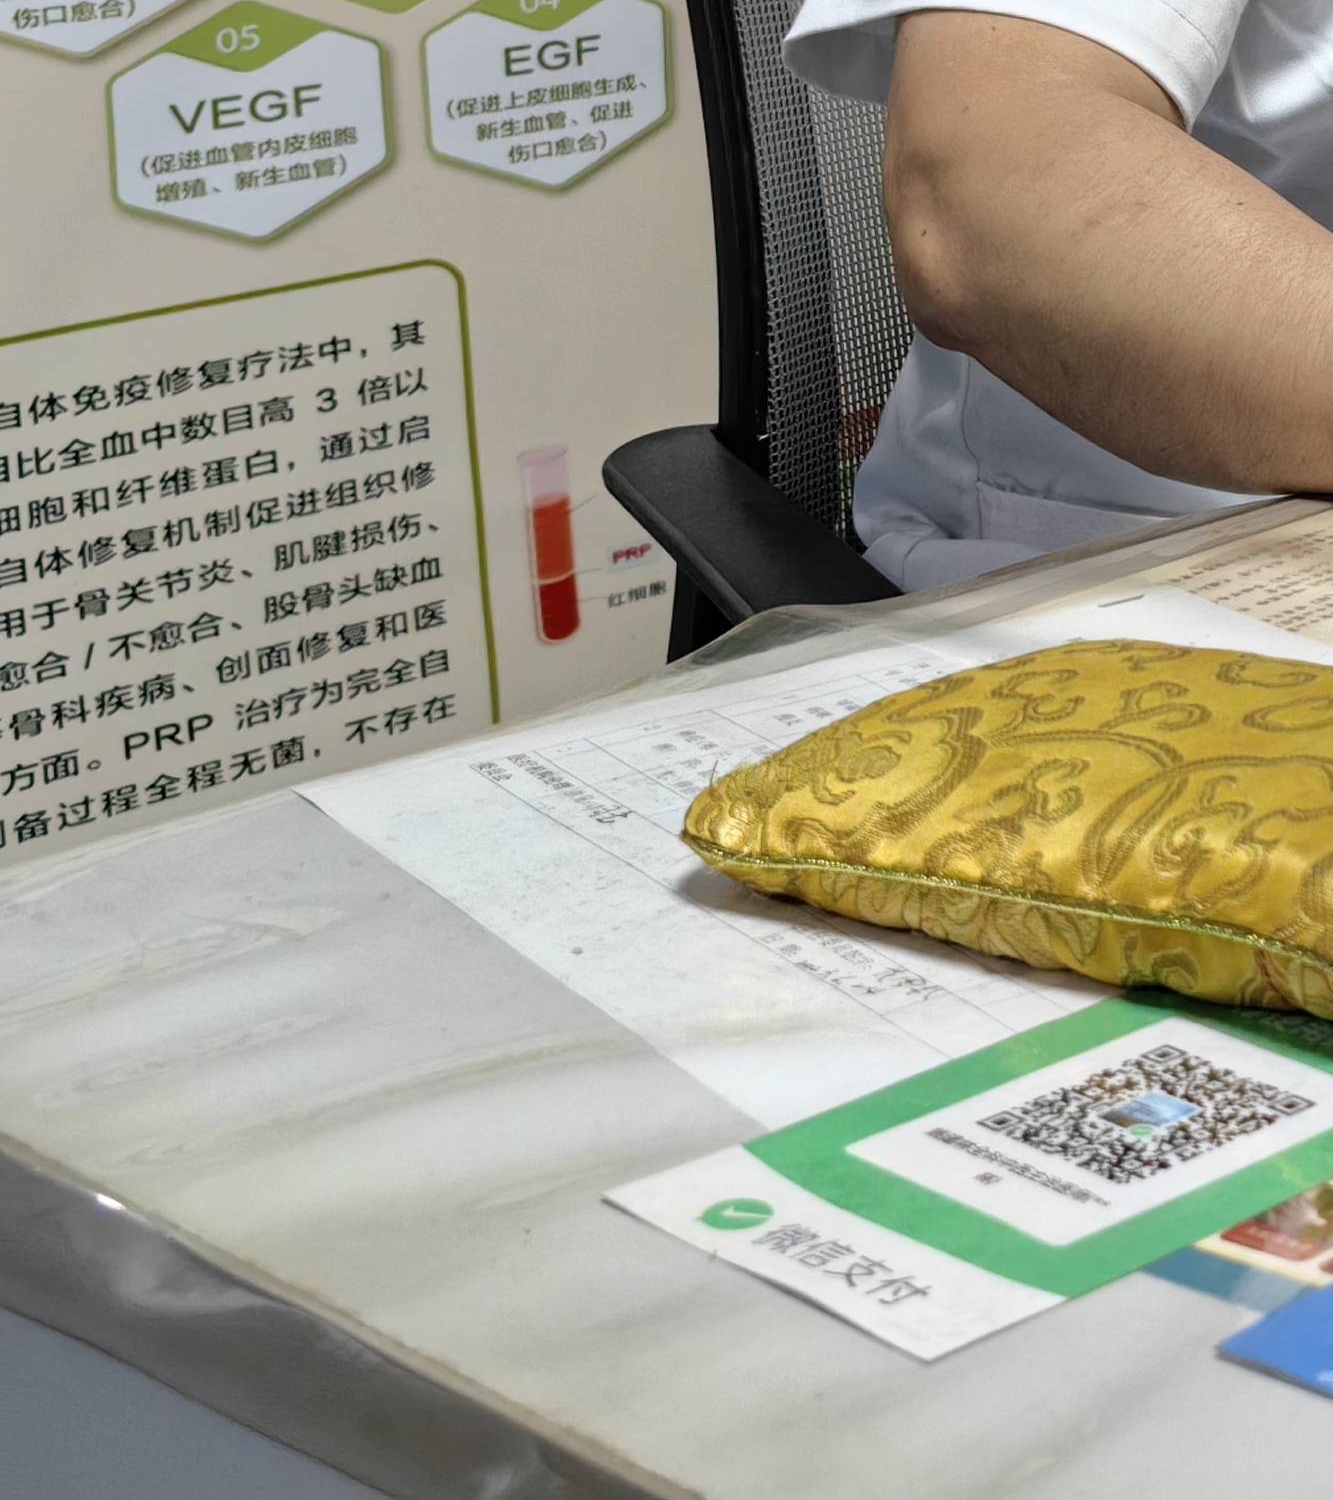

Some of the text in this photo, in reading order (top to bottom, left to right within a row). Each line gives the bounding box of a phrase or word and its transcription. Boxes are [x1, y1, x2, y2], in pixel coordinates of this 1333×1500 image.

[215, 26, 260, 53] 05
[502, 35, 602, 77] EGF
[168, 84, 323, 135] VEGF
[446, 74, 650, 118] (促进上皮细胞生成、
[475, 100, 634, 142] 新生血管、促进
[140, 126, 358, 178] (促进血管内皮细胞
[507, 130, 608, 165] 伤口愈合)
[155, 157, 349, 203] 增殖、新生血管)
[316, 387, 339, 413] 3
[357, 366, 429, 406] 倍以
[612, 543, 652, 565] PRP
[0, 599, 447, 742] 骨科疾病、创面修复和医
[123, 713, 214, 760] PRP
[236, 649, 450, 732] 治疗为完全自
[0, 694, 456, 849] 备过程全程无菌,不存在
[751, 1223, 933, 1305] 微信支付
